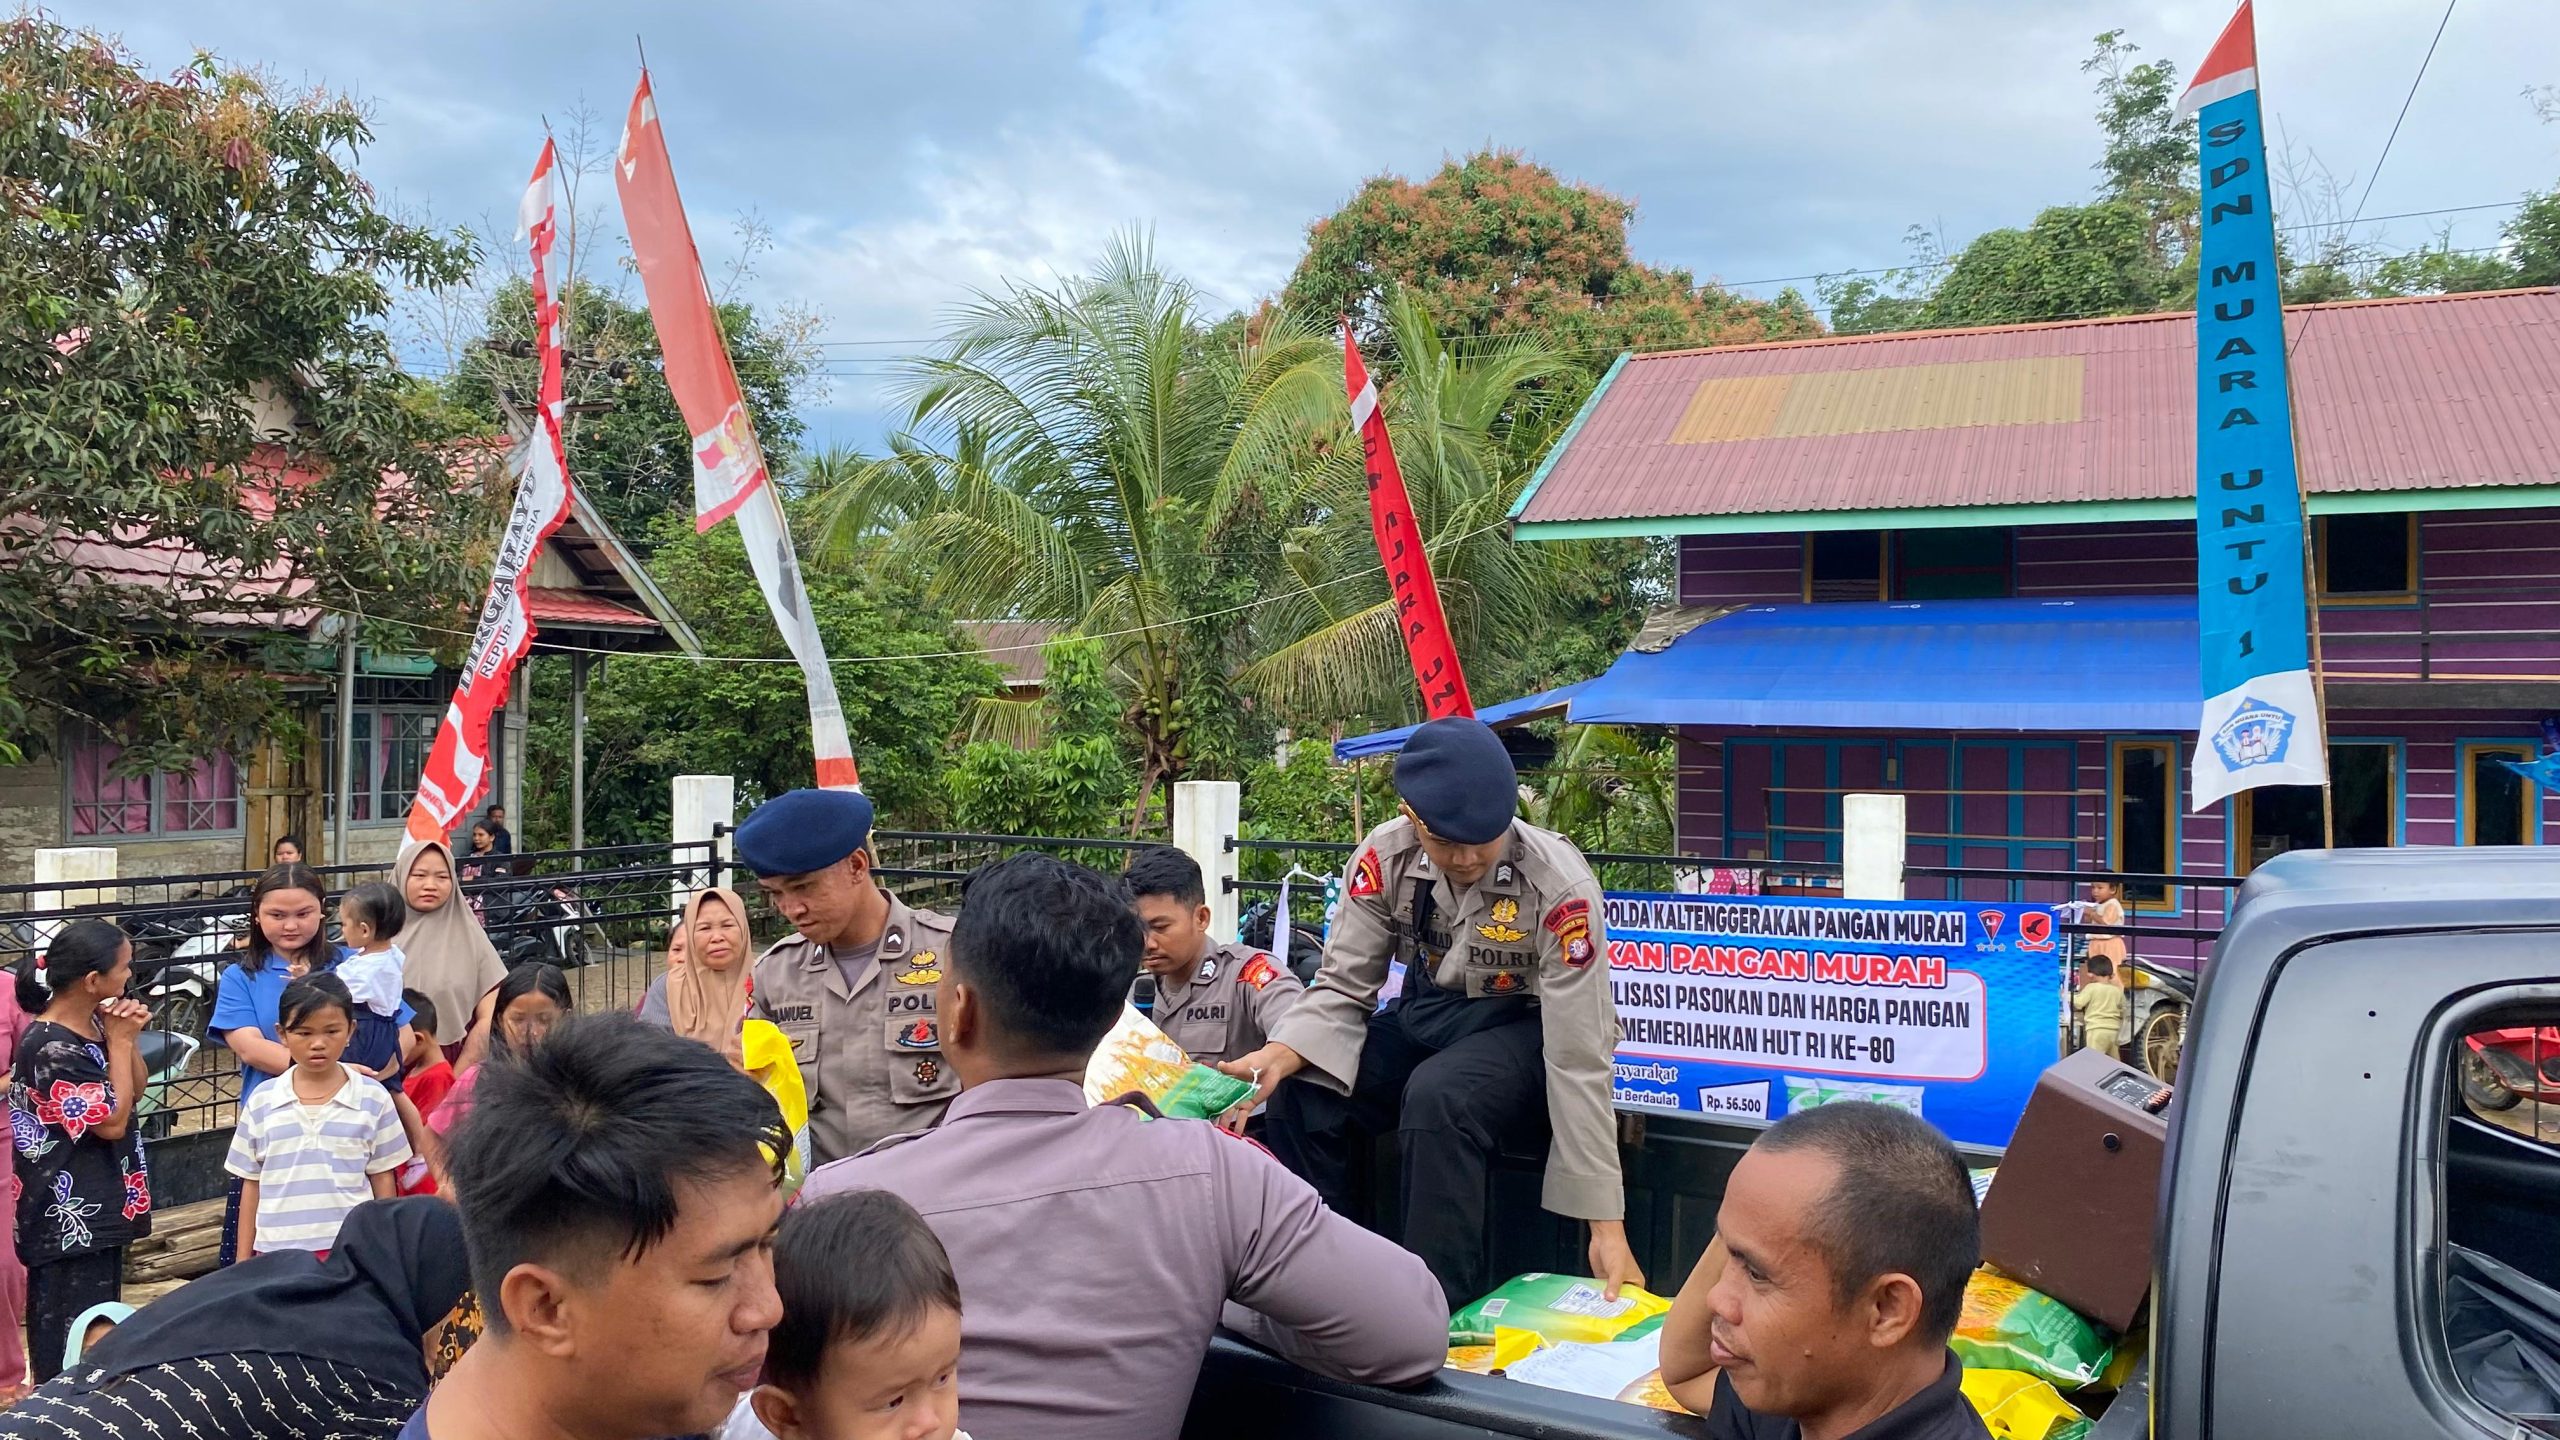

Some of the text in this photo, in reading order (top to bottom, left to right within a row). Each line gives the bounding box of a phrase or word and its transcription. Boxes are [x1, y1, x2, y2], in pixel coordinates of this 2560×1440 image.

[2207, 119, 2269, 659] SDN MUARA UNTU 1
[1654, 903, 1810, 938] KALTENGGERAKAN
[1814, 910, 1890, 941] PANGAN
[1894, 913, 1964, 943] MURAH
[1469, 945, 1534, 966] POLRI
[1607, 942, 1943, 985] KAN PANGAN MURAH
[889, 993, 936, 1012] POL
[1186, 1005, 1225, 1021] POLRI
[1675, 985, 1763, 1016] PASOKAN
[1767, 991, 1806, 1020] DAN
[1811, 994, 1881, 1025] HARGA
[1885, 999, 1970, 1028] PANGAN
[1622, 1016, 1895, 1064] MEMERIAHKAN HUT RI KE-80
[1613, 1062, 1677, 1083] asyarakat
[1625, 1090, 1677, 1106] Berdaulat
[1706, 1095, 1761, 1113] Rp. 56.500
